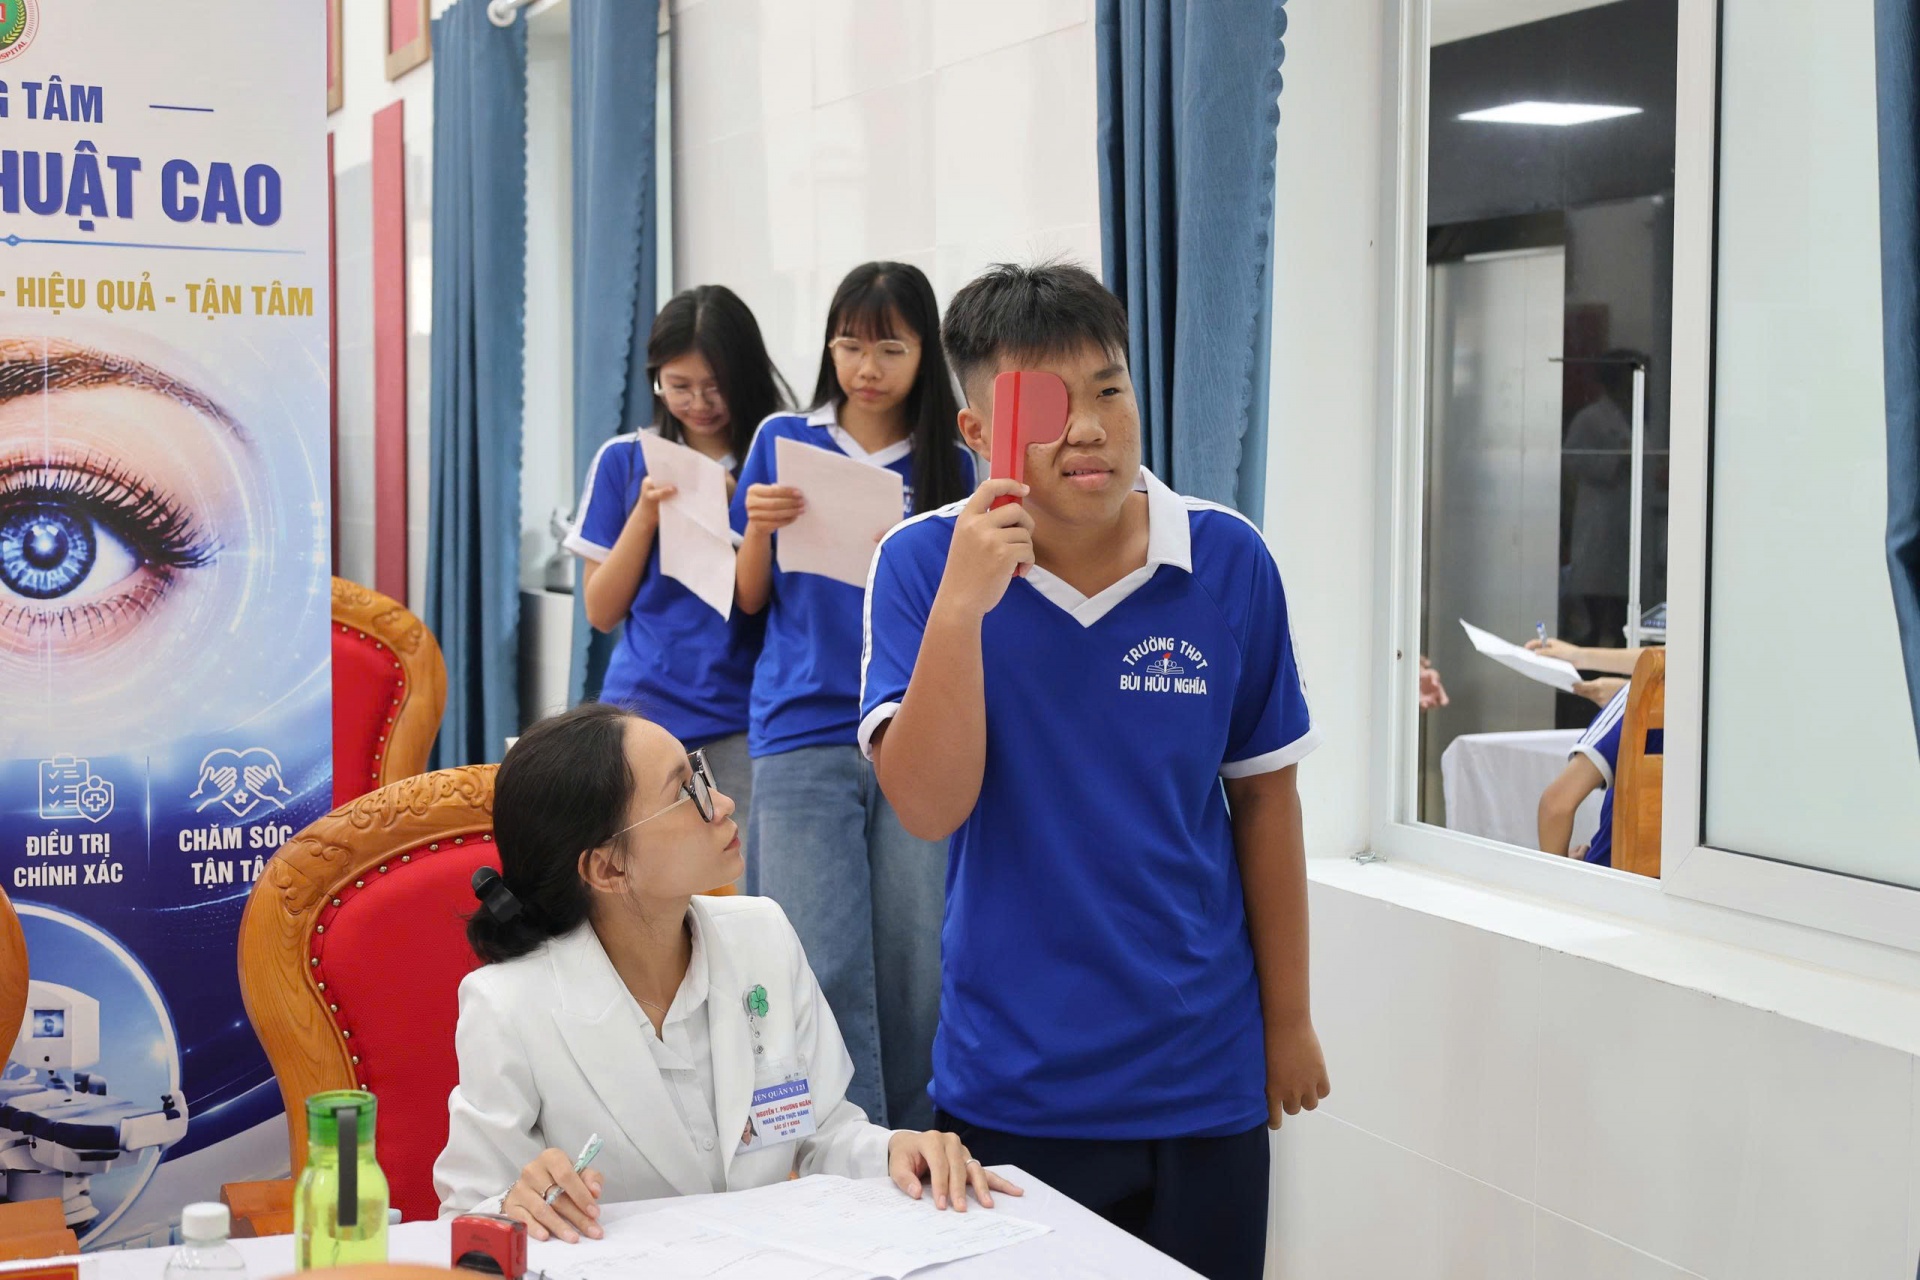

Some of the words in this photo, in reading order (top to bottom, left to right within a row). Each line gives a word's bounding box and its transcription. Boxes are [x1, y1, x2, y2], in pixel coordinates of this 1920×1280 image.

[0, 40, 28, 60] SPITAL
[21, 75, 104, 124] TÂM
[161, 158, 282, 227] CAO
[16, 271, 86, 315] HIỆU
[96, 271, 156, 314] QUẢ
[185, 278, 242, 321] TẬN
[251, 280, 314, 317] TÂM
[1122, 636, 1174, 666] TRƯỜNG
[1180, 640, 1208, 669] THPT
[1120, 672, 1140, 691] BÙI
[1144, 674, 1170, 692] HỮU
[1174, 676, 1207, 695] NGHĨA
[26, 828, 73, 857] ĐIỀU
[79, 833, 111, 858] TRỊ
[179, 823, 243, 852] CHĂM
[13, 861, 77, 888] CHÍNH
[83, 859, 124, 885] XÁC
[191, 857, 234, 889] TẬN
[239, 854, 270, 882] TÂ
